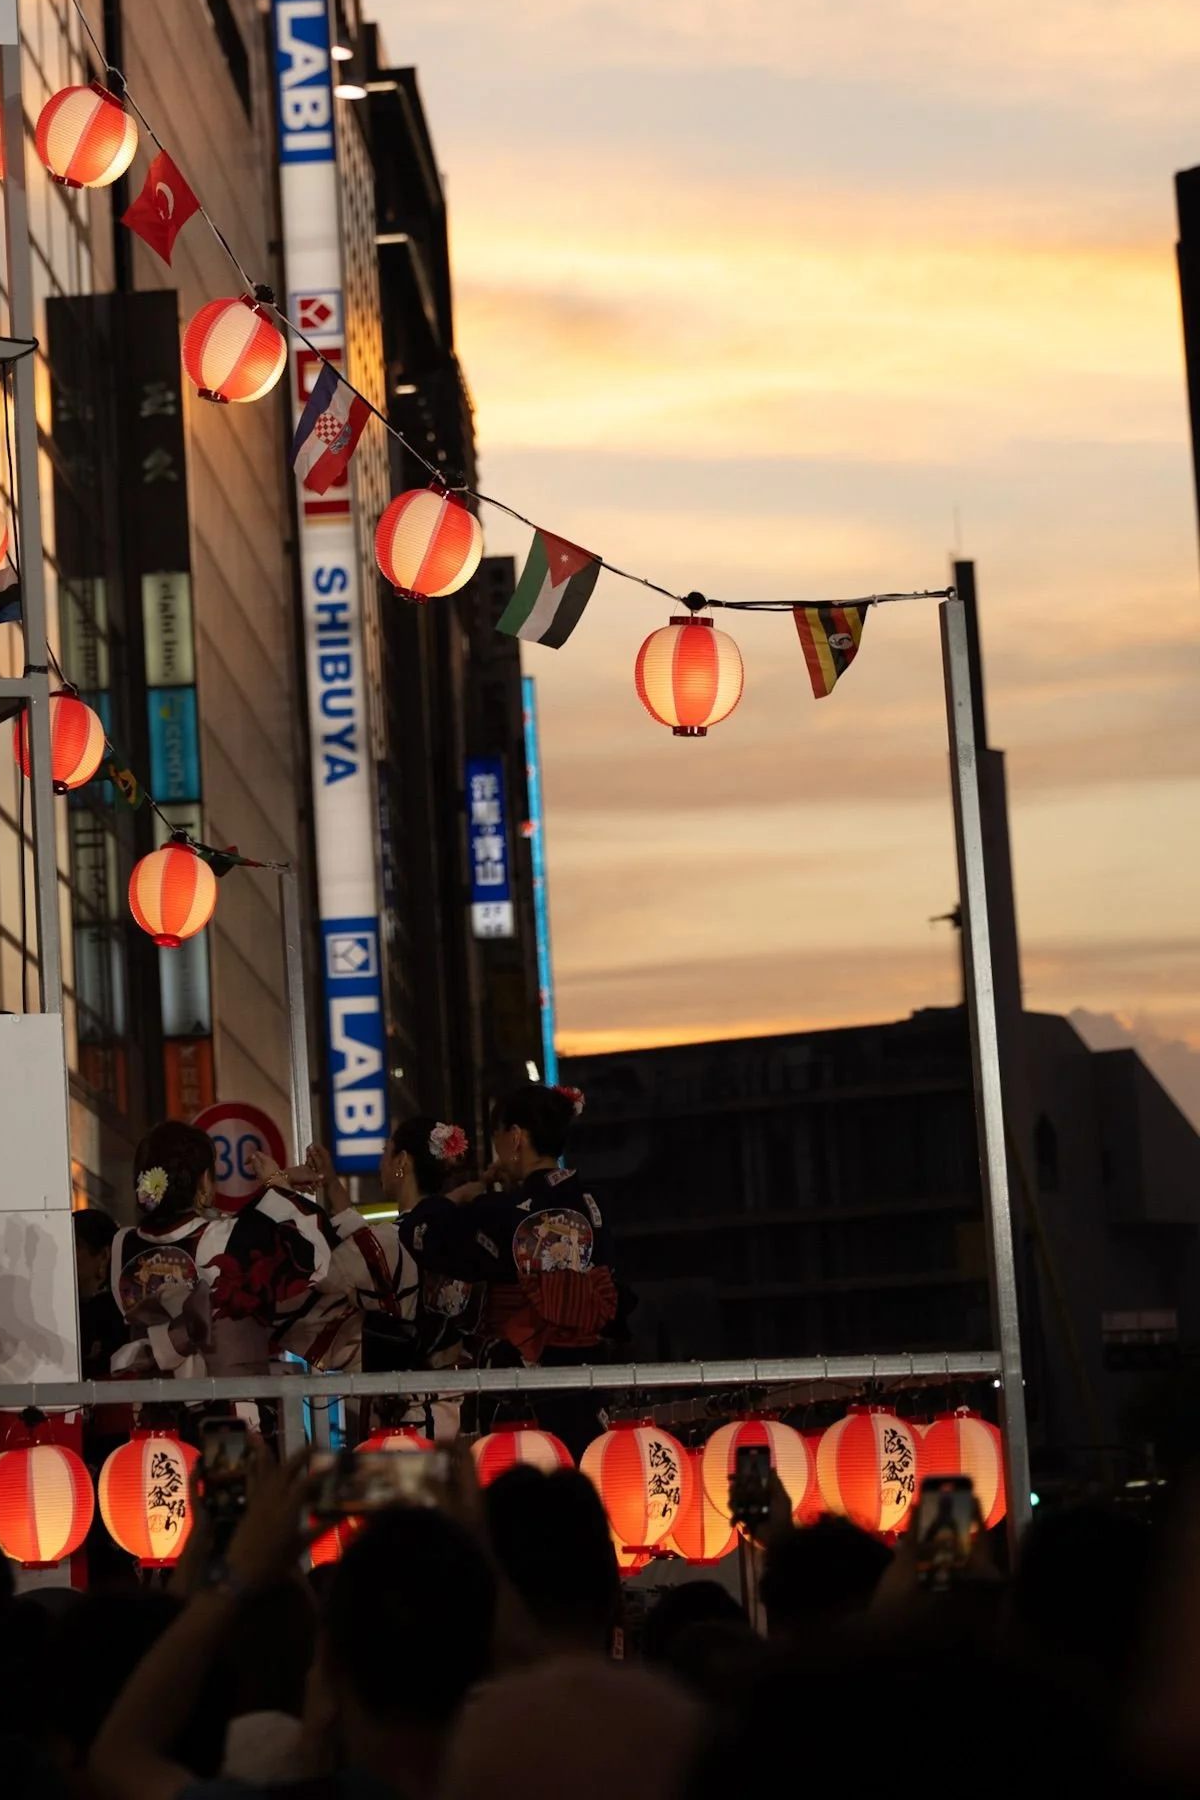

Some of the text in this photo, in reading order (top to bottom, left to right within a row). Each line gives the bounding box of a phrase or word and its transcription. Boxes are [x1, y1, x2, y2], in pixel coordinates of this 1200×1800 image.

[275, 0, 333, 152] LABI
[313, 566, 360, 787] SHIBUYA
[329, 995, 386, 1157] LABI
[212, 1133, 263, 1182] 30
